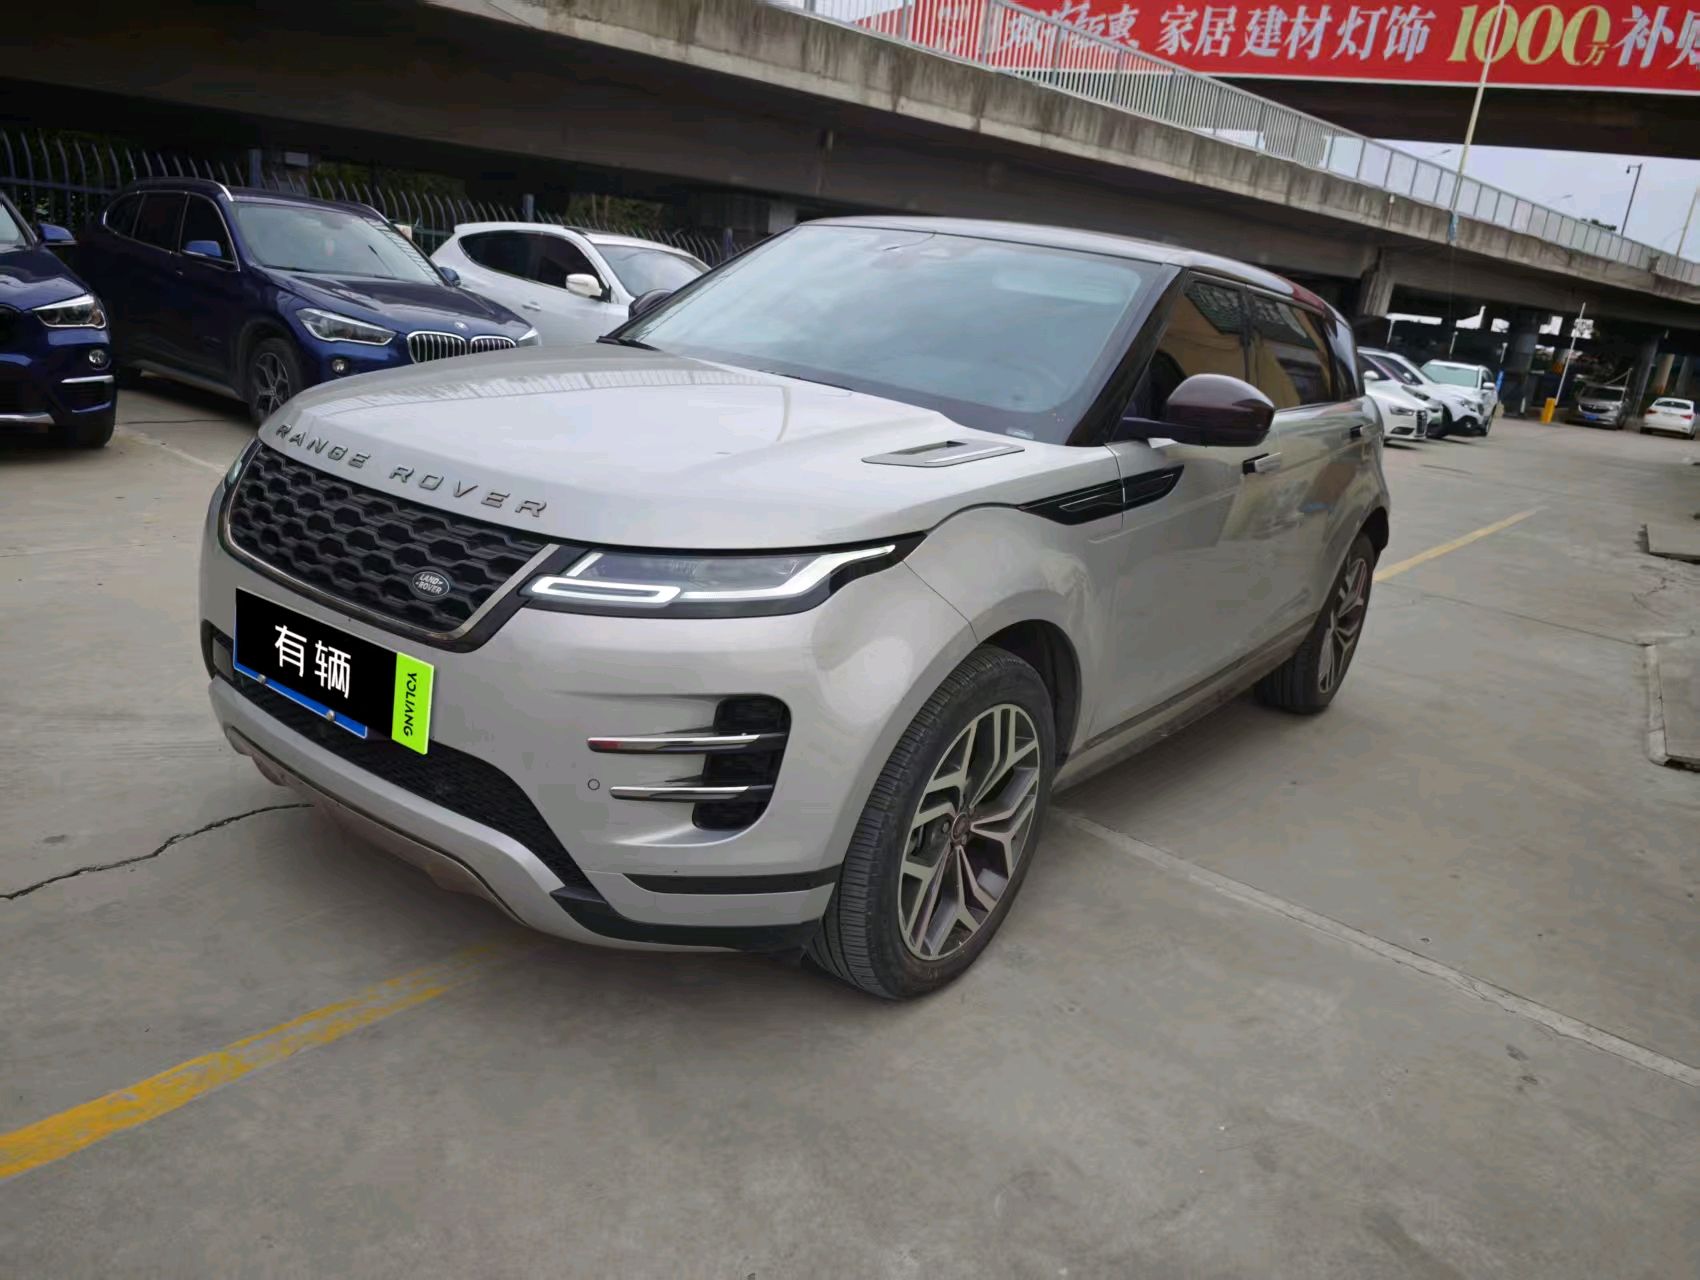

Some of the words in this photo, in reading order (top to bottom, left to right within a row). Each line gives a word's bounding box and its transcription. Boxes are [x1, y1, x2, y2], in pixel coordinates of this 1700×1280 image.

[1154, 4, 1437, 62] 家居建材灯饰
[275, 424, 370, 468] RANGE
[389, 465, 547, 518] ROVER
[418, 581, 442, 595] ROVER
[419, 573, 441, 585] LAND
